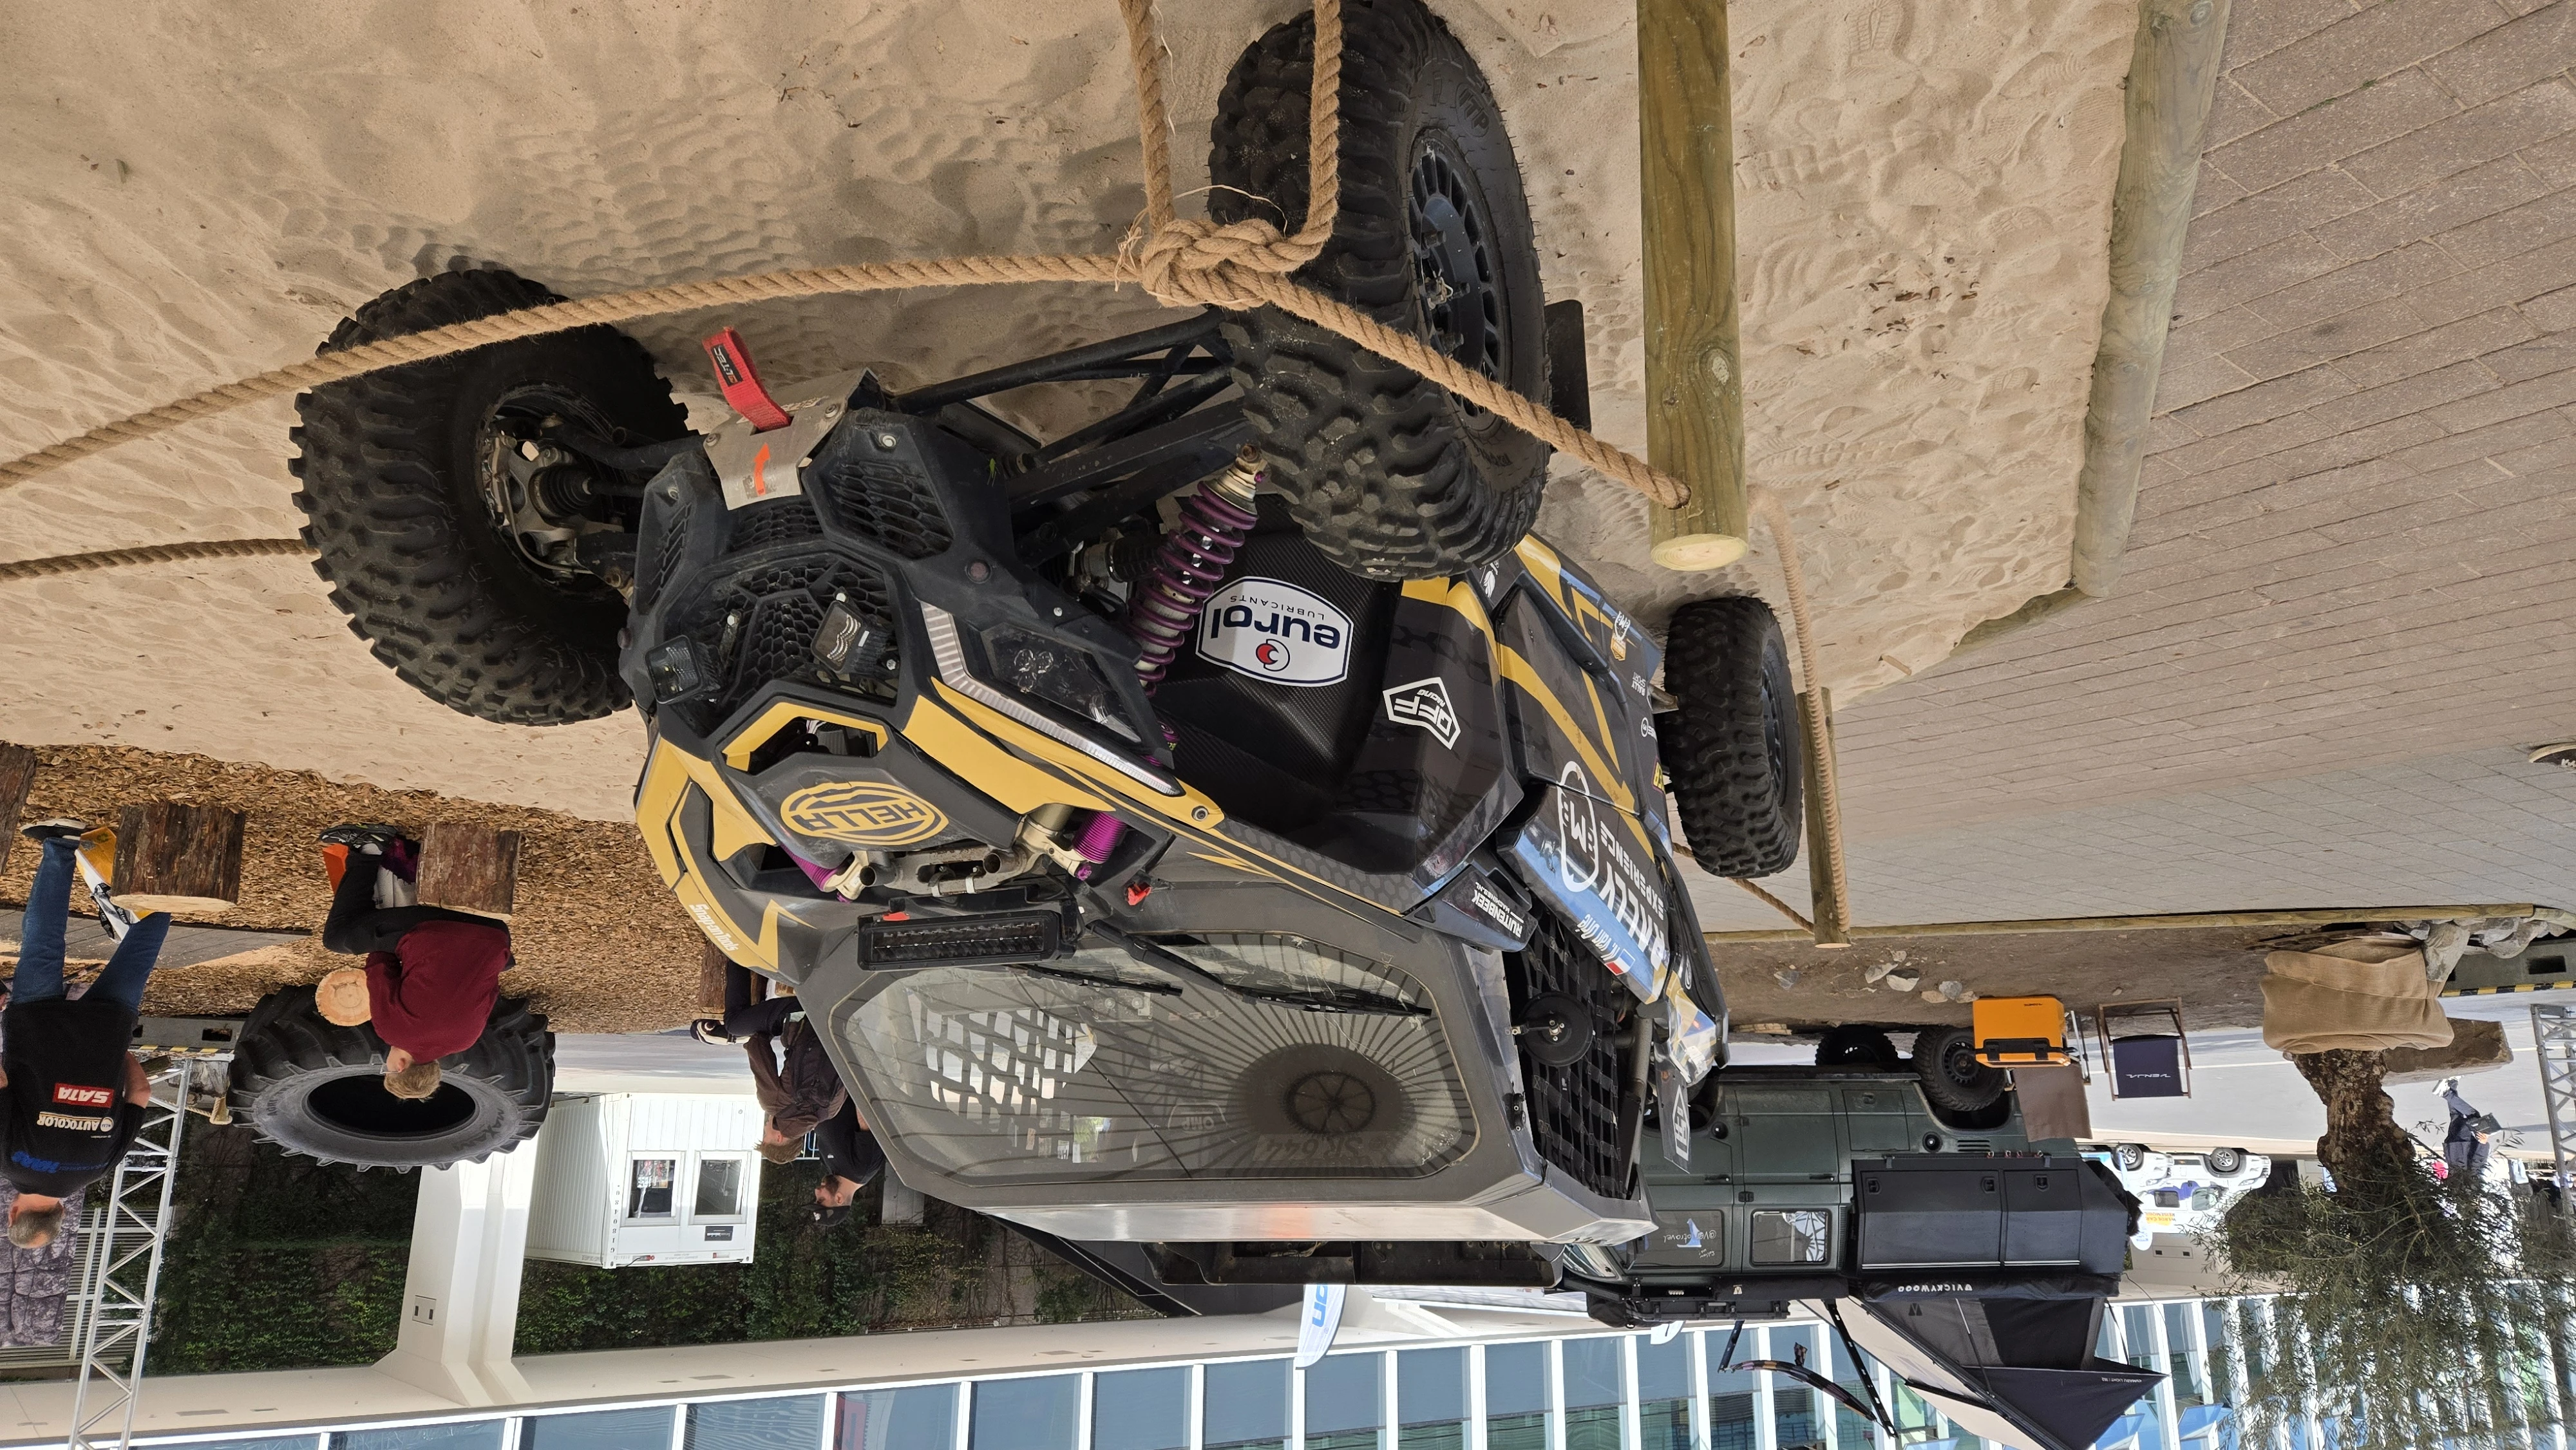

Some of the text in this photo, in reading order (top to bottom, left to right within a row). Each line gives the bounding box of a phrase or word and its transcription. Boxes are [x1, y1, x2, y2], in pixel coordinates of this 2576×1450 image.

[1229, 594, 1325, 621] LUBRICANTS
[1210, 605, 1341, 649] eurol
[1631, 680, 1645, 696] RALLY
[1632, 672, 1646, 687] SPORT
[790, 801, 927, 832] HELLA
[1600, 820, 1664, 921] EXPERIENCE
[1471, 889, 1523, 938] RUITENBEEK
[1598, 861, 1665, 971] RALLY
[1591, 929, 1611, 951] van
[57, 1086, 110, 1104] SATA
[36, 1115, 99, 1131] AUTOCOLOR
